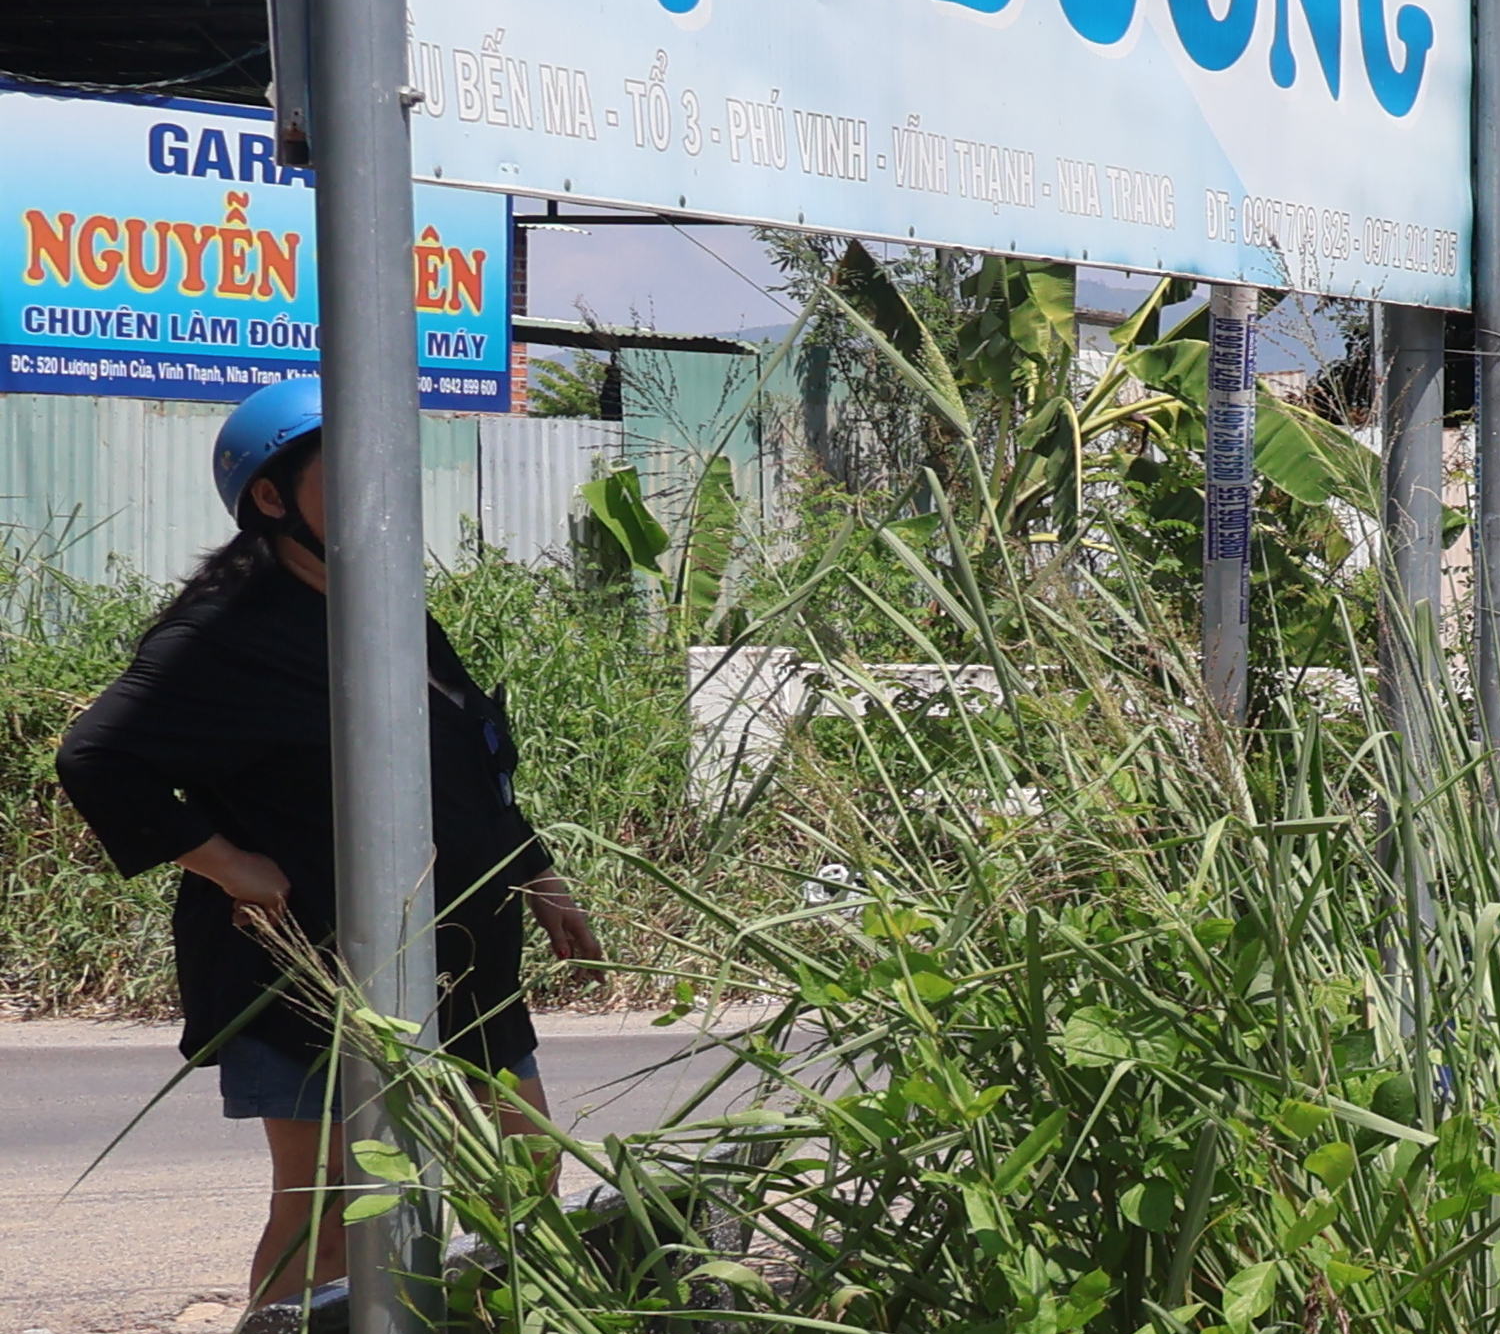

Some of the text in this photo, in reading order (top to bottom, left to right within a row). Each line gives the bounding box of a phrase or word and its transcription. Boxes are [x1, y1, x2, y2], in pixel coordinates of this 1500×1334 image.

[453, 27, 534, 131] BẾN
[539, 63, 597, 141] MA
[624, 48, 671, 152] TỔ
[681, 88, 702, 156] 3
[726, 88, 788, 171] PHÚ
[793, 109, 868, 183] VINH
[892, 114, 949, 195] VĨNH
[953, 138, 1036, 215] THẠNH
[1057, 157, 1103, 218] NHA
[1105, 164, 1176, 230] TRANG
[23, 192, 488, 317] NGUYỄN ÊN
[1205, 188, 1236, 244] ĐT:
[1241, 195, 1282, 249] 0907
[1286, 202, 1318, 256] 709
[1322, 208, 1351, 261] 825
[1364, 216, 1401, 269] 0971
[1404, 223, 1429, 274] 201
[1433, 228, 1459, 277] 505
[11, 354, 34, 374] ĐC:
[36, 356, 58, 375] 520
[60, 357, 98, 381] Lương
[99, 359, 127, 381] Định
[226, 365, 248, 383] Nha
[22, 306, 159, 341] CHUYÊN
[170, 312, 239, 346] LÀM
[425, 328, 487, 360] MÁY
[439, 376, 461, 394] 0942
